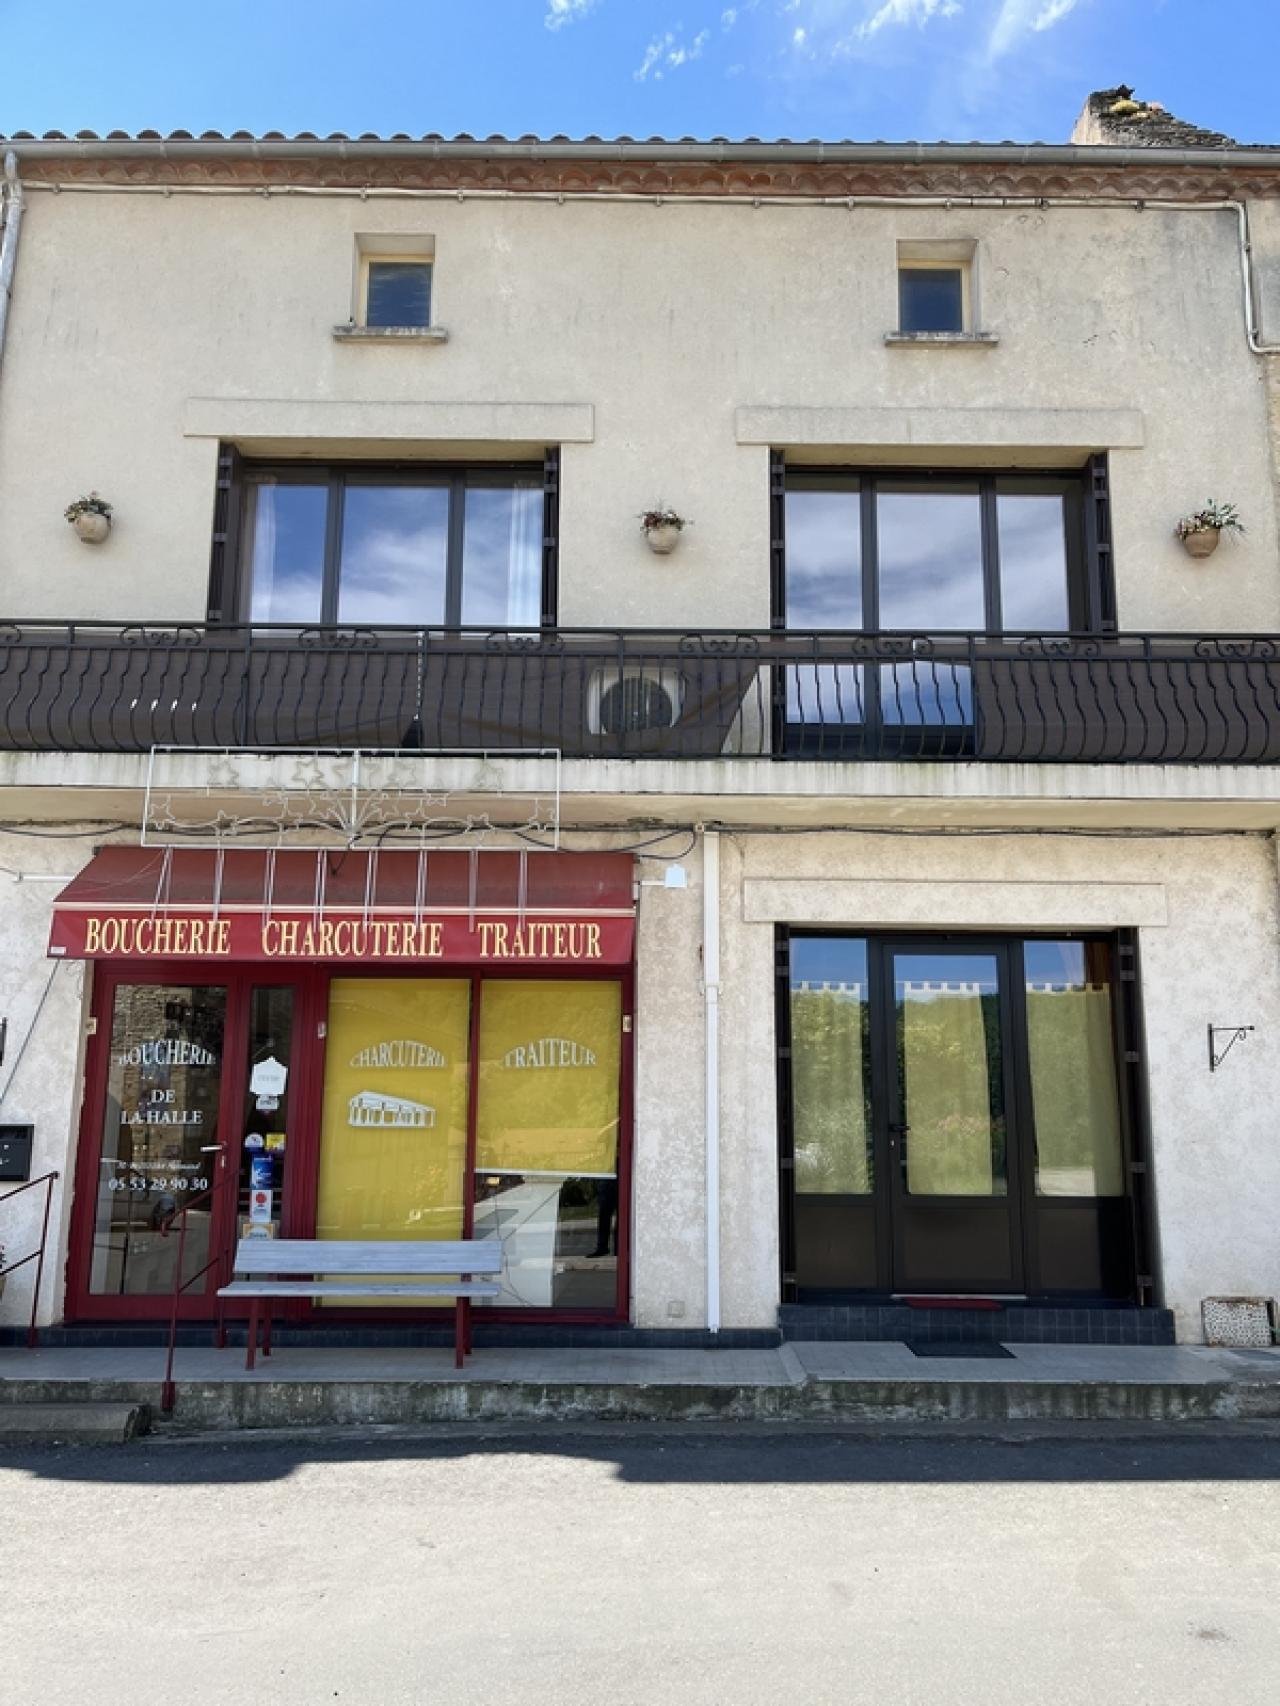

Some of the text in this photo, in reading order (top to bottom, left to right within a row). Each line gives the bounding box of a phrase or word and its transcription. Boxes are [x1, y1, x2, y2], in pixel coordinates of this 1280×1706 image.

[85, 918, 602, 959] BOUCHERIE CHARCUTERIE TRAITEUR
[505, 1038, 596, 1067] TRAITEUR
[151, 1089, 176, 1103] DE
[146, 1110, 204, 1124] HALLE
